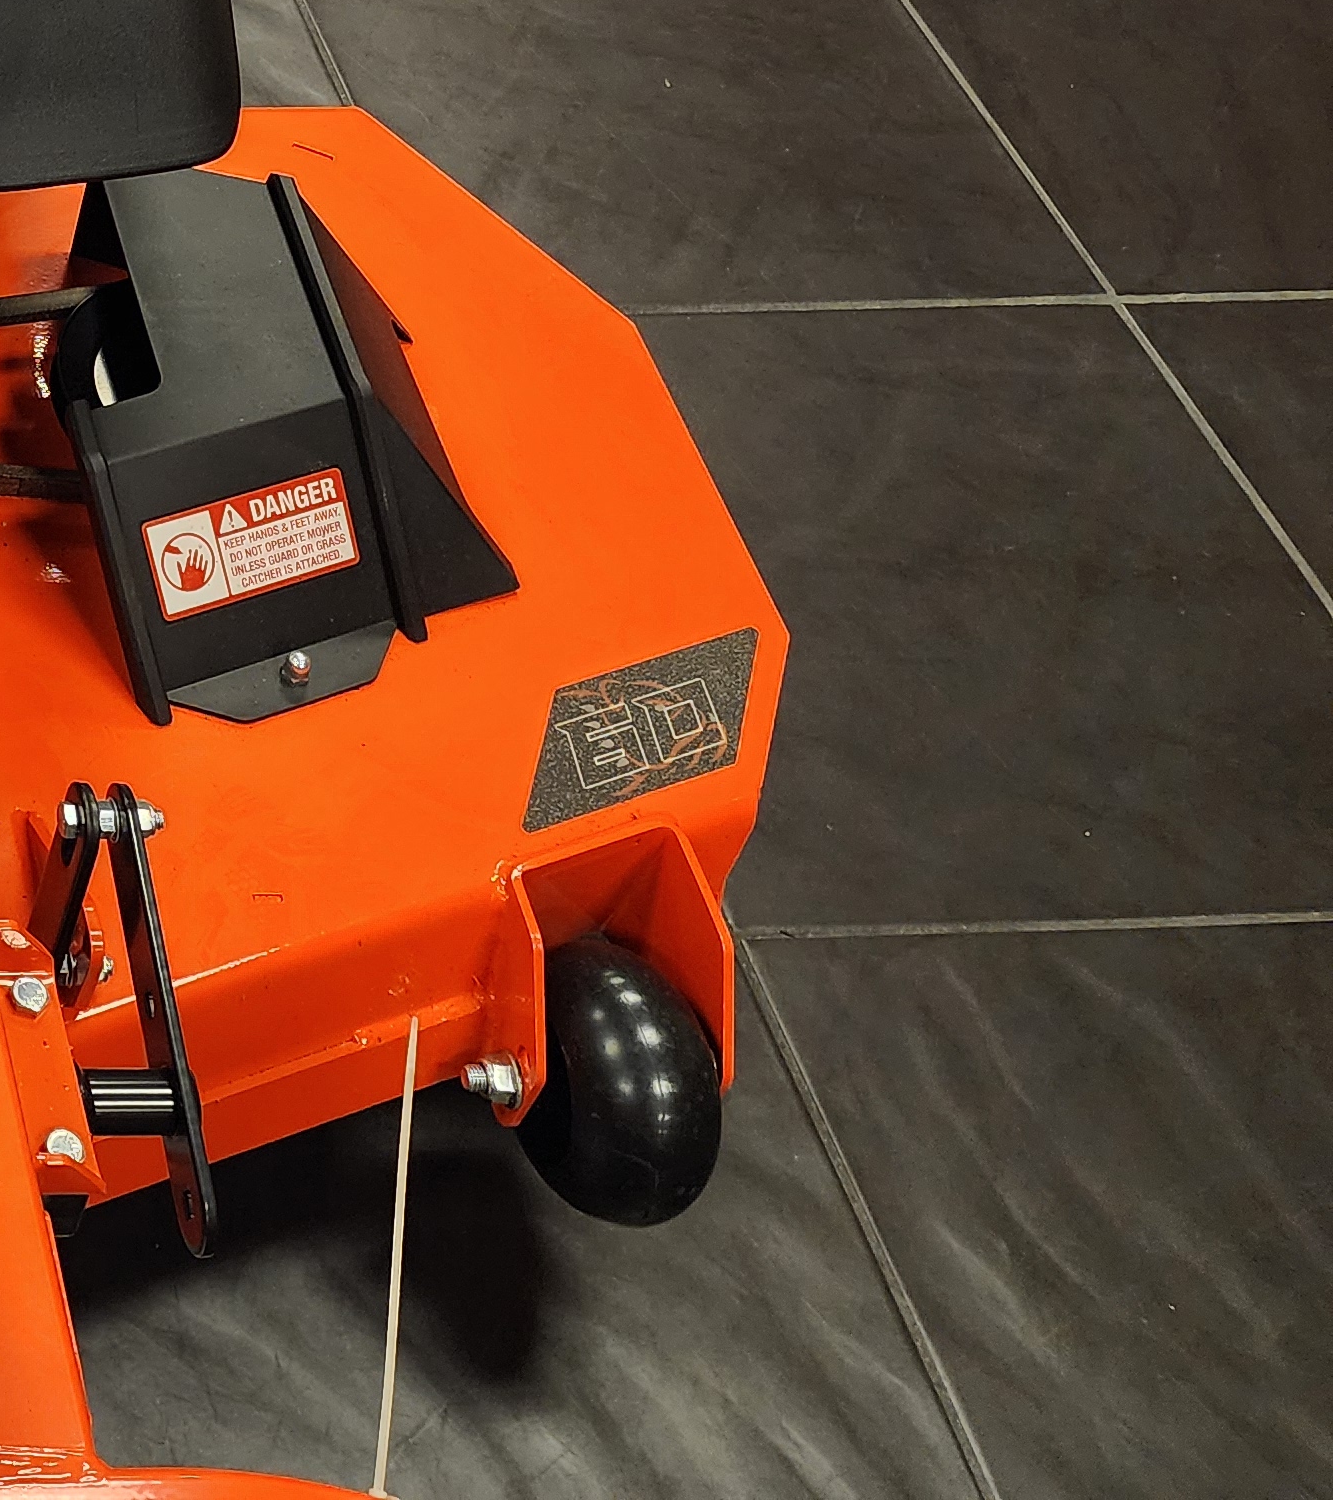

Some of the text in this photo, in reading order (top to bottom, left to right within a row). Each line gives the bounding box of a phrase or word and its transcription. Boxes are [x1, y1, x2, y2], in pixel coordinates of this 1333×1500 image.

[249, 477, 337, 523] DANGER
[223, 507, 341, 550] KEEP HANDS & FEET AWAY.
[230, 521, 342, 563] DO NOT OPERATE MOWER
[231, 534, 346, 577] UNLESS GUARD OR GRASS
[241, 550, 343, 588] CATCHER IS ATTACHED.
